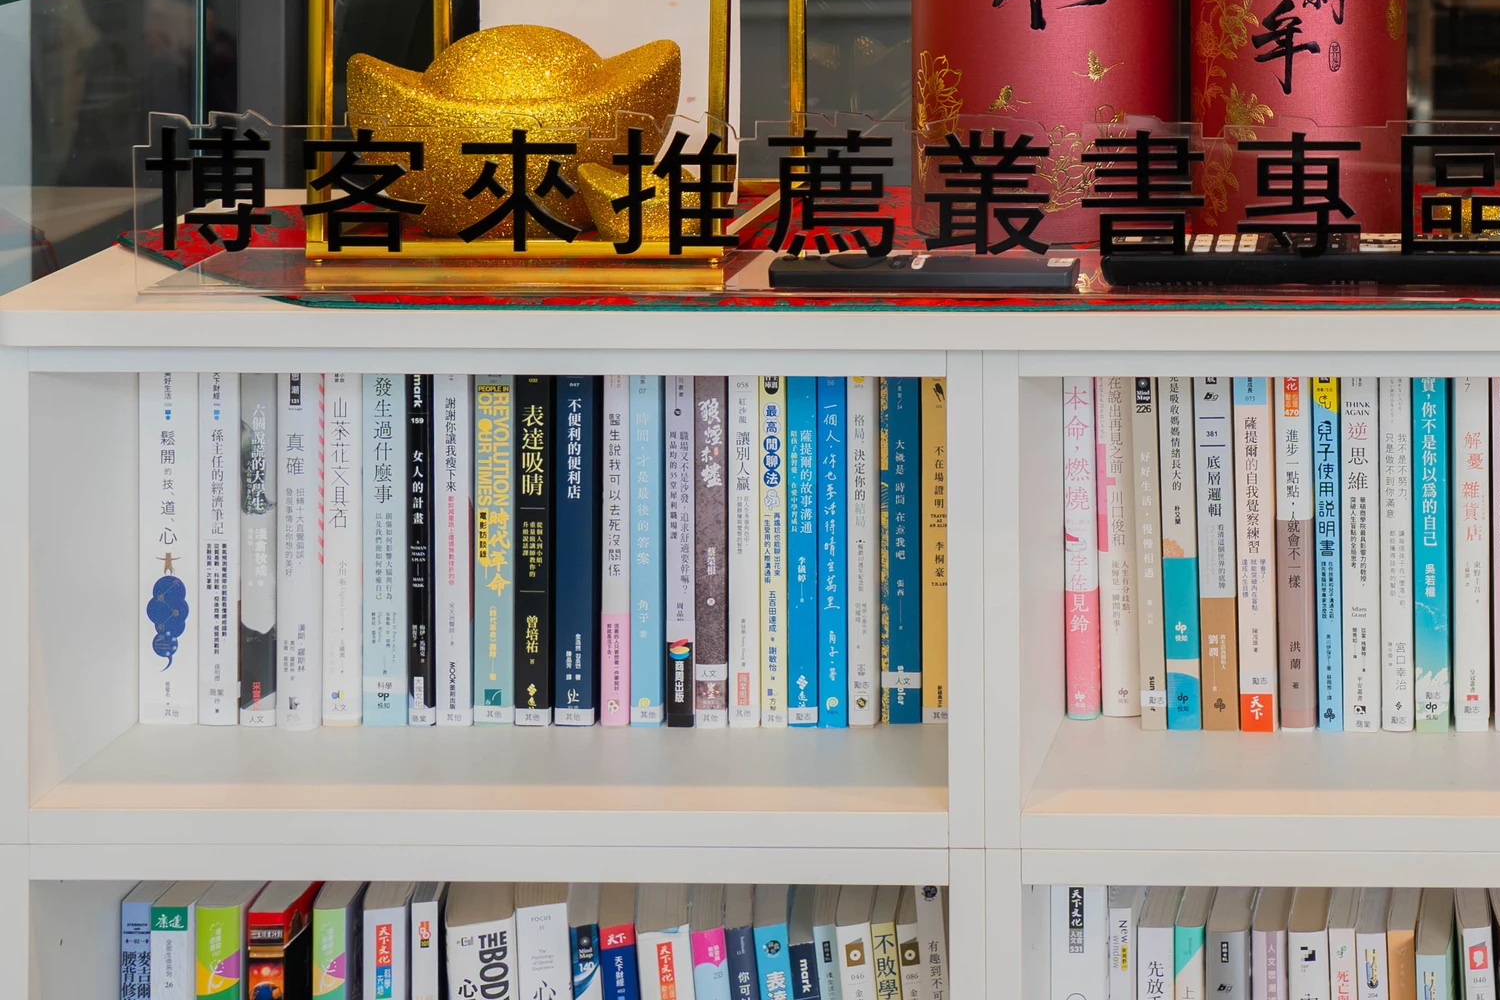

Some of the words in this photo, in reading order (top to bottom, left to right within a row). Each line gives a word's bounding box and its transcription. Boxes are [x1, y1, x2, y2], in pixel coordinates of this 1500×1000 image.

[477, 393, 492, 415] OF
[736, 381, 749, 389] 058
[1345, 401, 1370, 409] THINK
[1135, 405, 1152, 413] 226
[286, 433, 304, 475] 真確
[445, 397, 457, 491] 謝謝你讓我瘦下來
[493, 393, 510, 506] REVOLUTION
[521, 405, 544, 496] 表達吸睛
[567, 398, 582, 500] 不便利的便利店
[735, 431, 750, 491] 讓別人贏
[1064, 386, 1091, 511] 本命，燃燒
[1347, 422, 1369, 490] 逆思維
[211, 429, 224, 535] 孫主任的經濟筆記
[412, 450, 424, 525] 女人的計畫
[477, 458, 493, 506] TIMES
[800, 430, 813, 534] 薩提爾的故事溝通
[854, 414, 866, 528] 格局，決定你的結局
[934, 446, 945, 509] 不在場證明
[1206, 455, 1222, 517] 底層邏輯
[1244, 416, 1260, 554] 薩提爾的自我覺察練習
[1317, 420, 1336, 557] 兒子使用說明書
[1385, 433, 1395, 518] 只是做不到你滿意
[1462, 432, 1484, 541] 解憂雜貨店
[608, 413, 621, 577] 醫生說我可以去死沒關係
[479, 512, 488, 558] 電影訪談錄
[1110, 491, 1125, 547] 川口俊和
[1069, 556, 1091, 634] 宇佐見鈴
[1241, 559, 1249, 598] 達成人生目標
[768, 591, 777, 633] 五百田達成
[701, 669, 716, 677] 人文
[1289, 641, 1301, 670] 洪蘭
[674, 660, 685, 703] 商周出版
[164, 708, 179, 717] 其他
[332, 704, 347, 712] 人文
[486, 710, 502, 719] 其他
[525, 713, 540, 722] 其他
[565, 713, 581, 721] 其他
[1250, 696, 1263, 720] 天下
[155, 913, 185, 928] 康健
[1071, 888, 1083, 927] 天下文化
[377, 925, 391, 965] 天下文化
[478, 931, 507, 949] THE
[606, 933, 627, 945] 天下
[1118, 919, 1128, 944] New
[578, 962, 595, 972] 140
[659, 944, 674, 983] 天下文化
[713, 970, 724, 979] 233
[799, 959, 812, 993] mark
[851, 973, 865, 981] 046
[873, 933, 898, 1000] 不敗學
[905, 973, 919, 981] 086
[1473, 976, 1487, 984] 040
